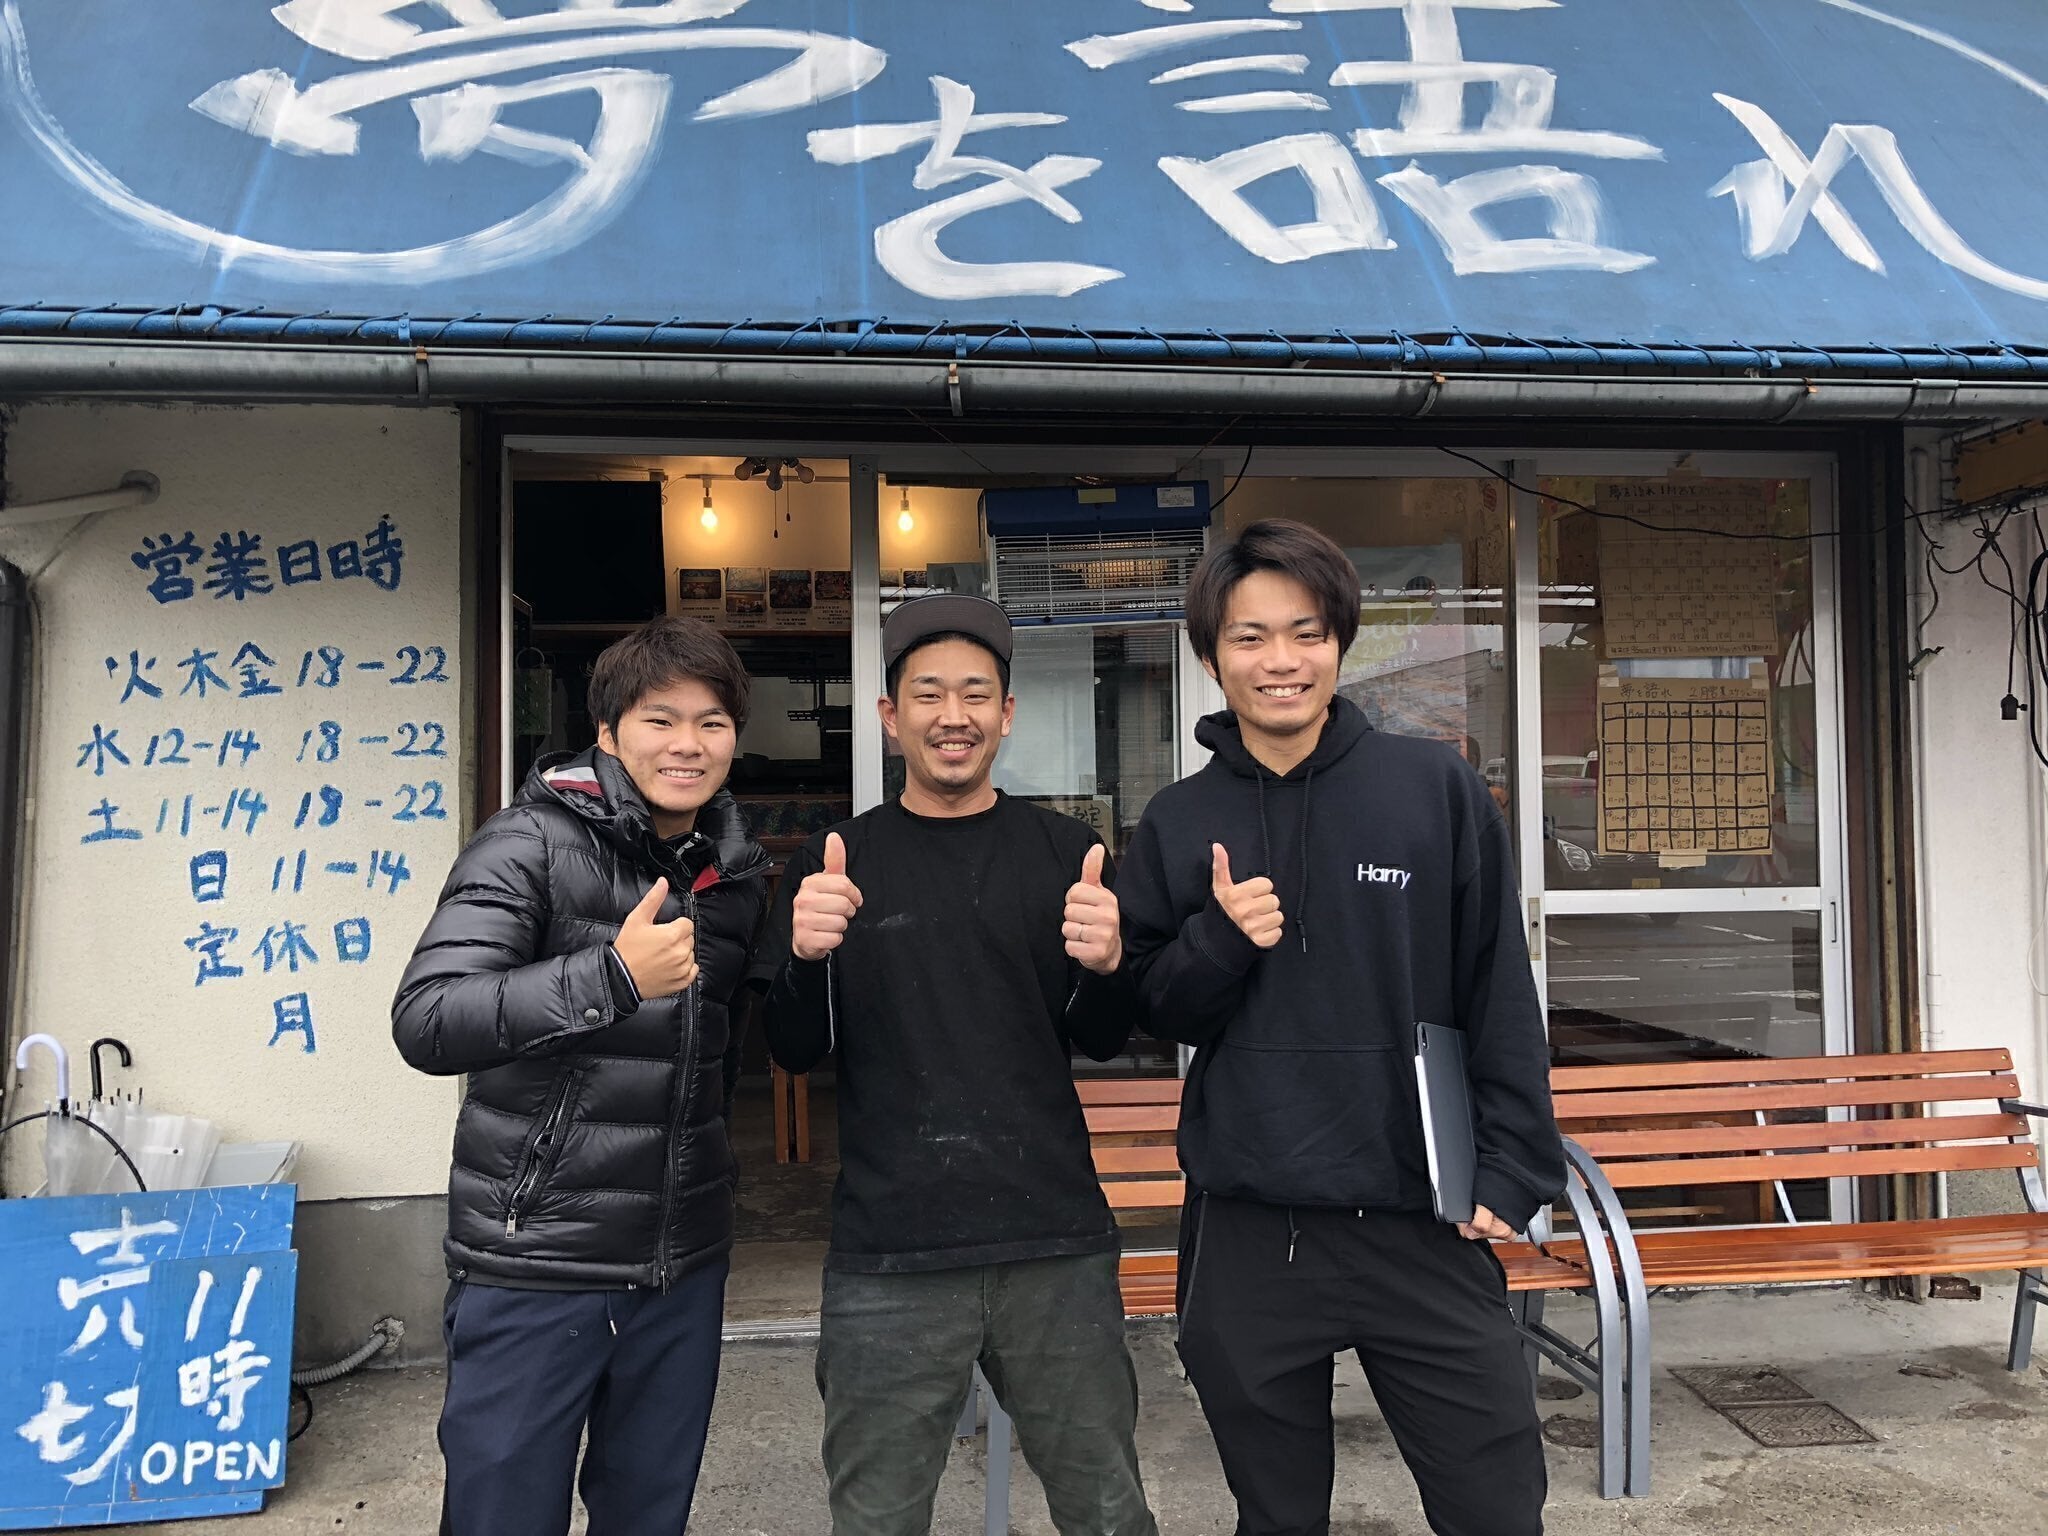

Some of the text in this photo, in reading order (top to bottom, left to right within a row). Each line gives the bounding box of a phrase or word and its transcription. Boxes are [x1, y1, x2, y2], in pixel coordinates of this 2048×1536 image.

[130, 514, 406, 604] 営業日時
[76, 723, 130, 776] 水
[80, 798, 144, 844] 土
[189, 849, 228, 903] 日
[1357, 863, 1411, 890] Harry
[183, 916, 371, 987] 定休日
[268, 991, 316, 1053] 月
[140, 1438, 281, 1486] OPEN
